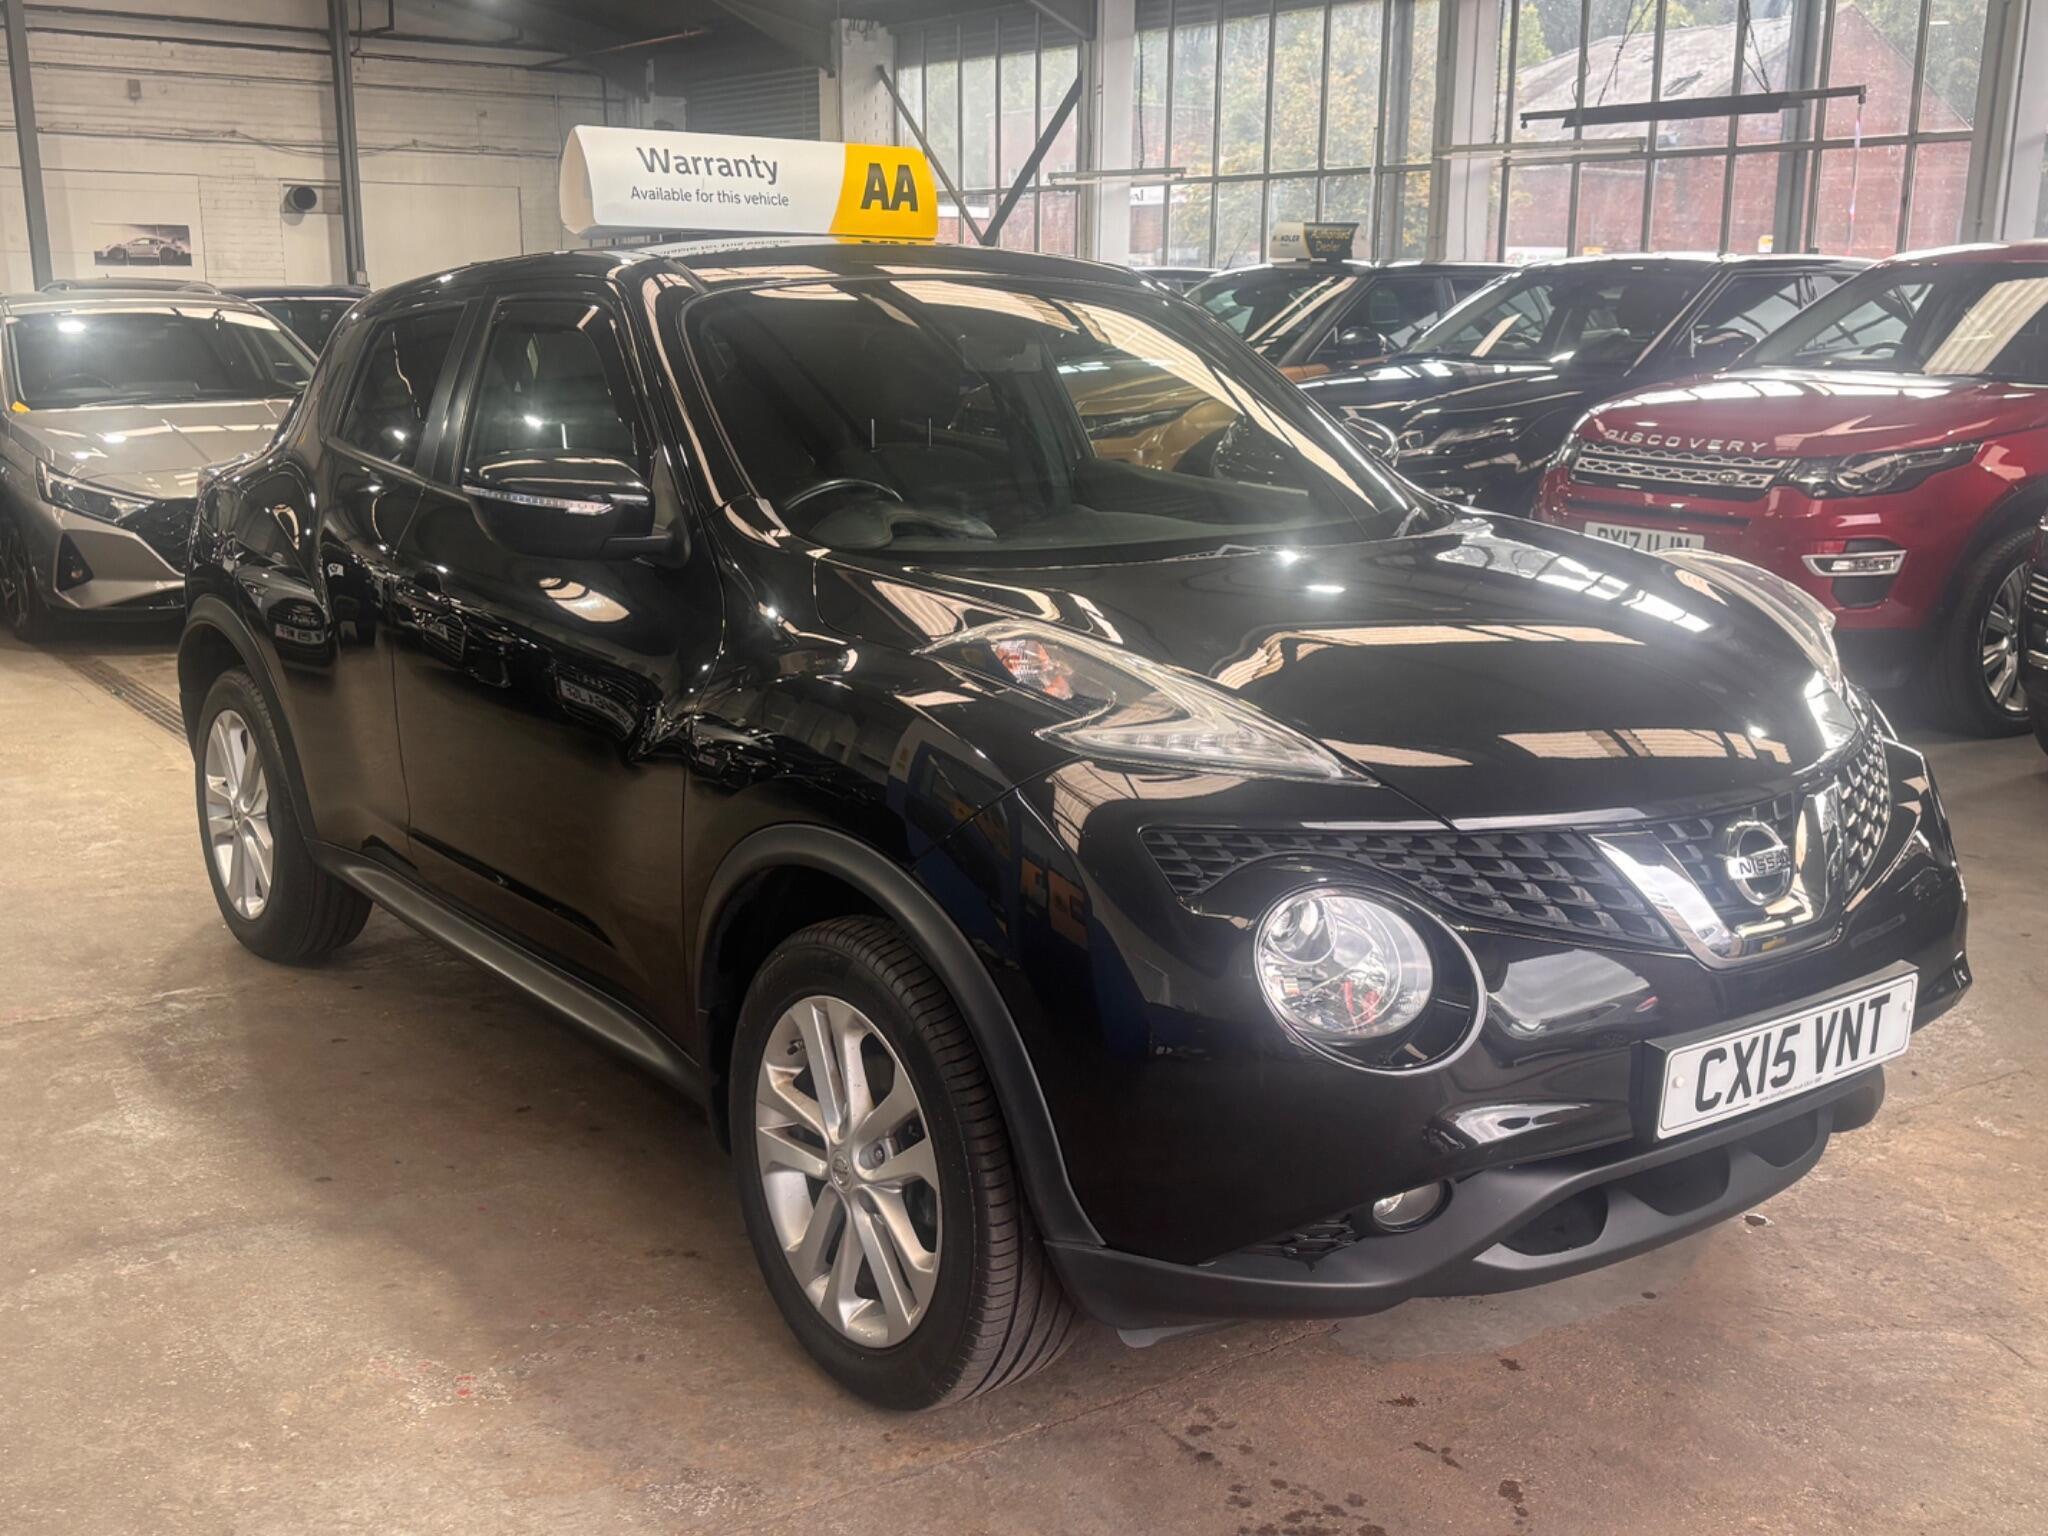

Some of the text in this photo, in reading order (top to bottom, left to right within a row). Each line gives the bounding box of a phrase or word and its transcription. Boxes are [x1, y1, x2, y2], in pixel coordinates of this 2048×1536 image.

[636, 147, 777, 185] Warranty
[631, 185, 789, 206] Available for this vehicle
[860, 163, 918, 211] AA
[1605, 429, 1768, 453] DISCOVERY
[1739, 848, 1791, 875] NISSAN
[1694, 993, 1891, 1113] CX15 VNT
